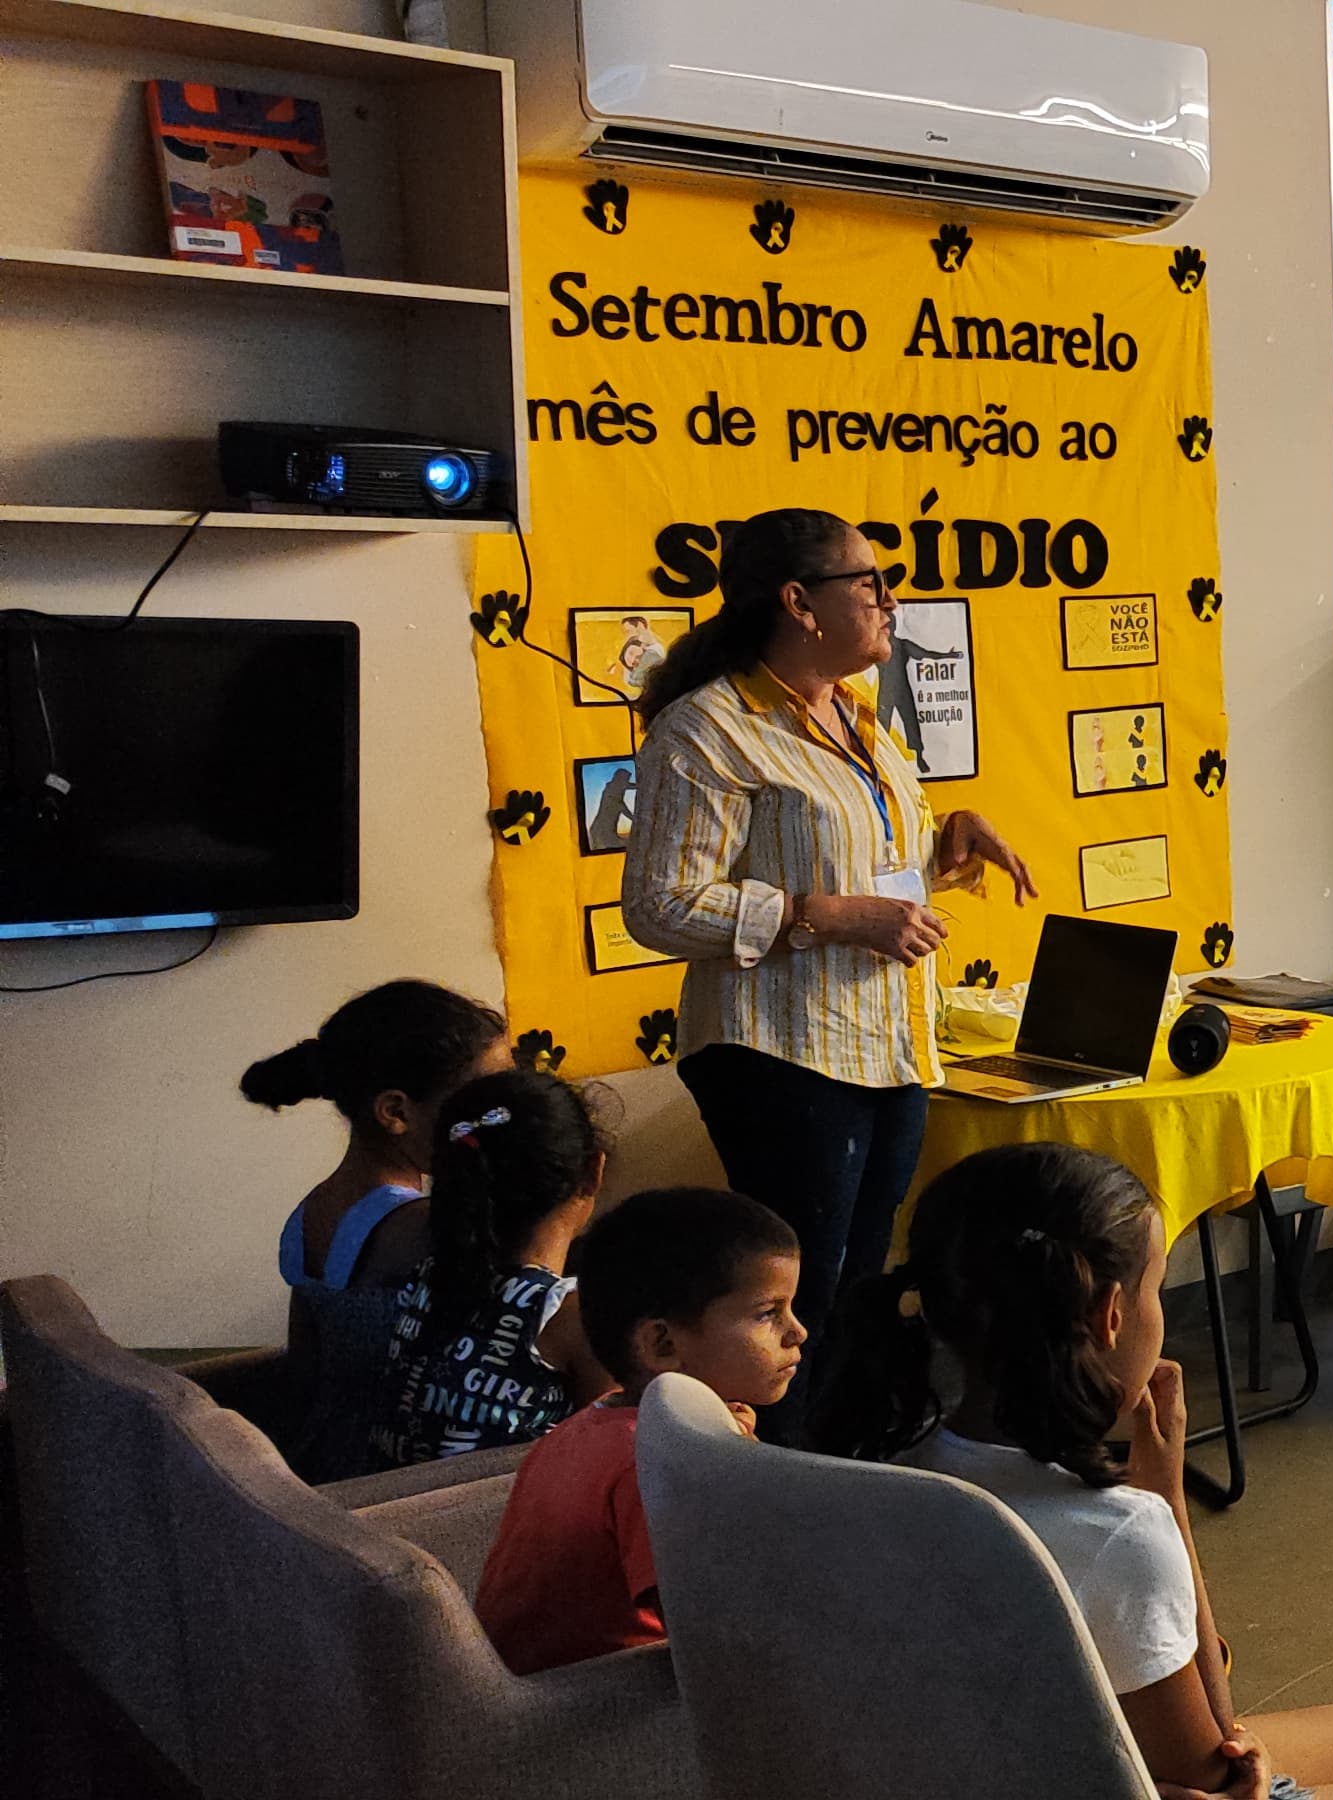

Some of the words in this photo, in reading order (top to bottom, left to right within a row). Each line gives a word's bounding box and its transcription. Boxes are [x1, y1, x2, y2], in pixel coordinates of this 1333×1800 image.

[548, 271, 868, 352] Setembro
[905, 297, 1139, 373] Amarelo
[527, 380, 658, 447] mês
[687, 390, 756, 447] de
[787, 403, 1040, 468] prevenção
[1059, 417, 1118, 462] ao
[655, 487, 1109, 599] SCÍDIO
[1110, 602, 1148, 615] VOCÊ
[1110, 614, 1149, 631] NÃO
[1111, 630, 1150, 645] ESTÁ
[916, 662, 957, 682] Falar
[917, 690, 924, 703] é
[926, 692, 933, 703] a
[935, 689, 969, 702] melhor
[918, 706, 963, 726] SOLUÇÃO
[480, 1314, 524, 1367] GIRL
[464, 1367, 533, 1408] GIRL
